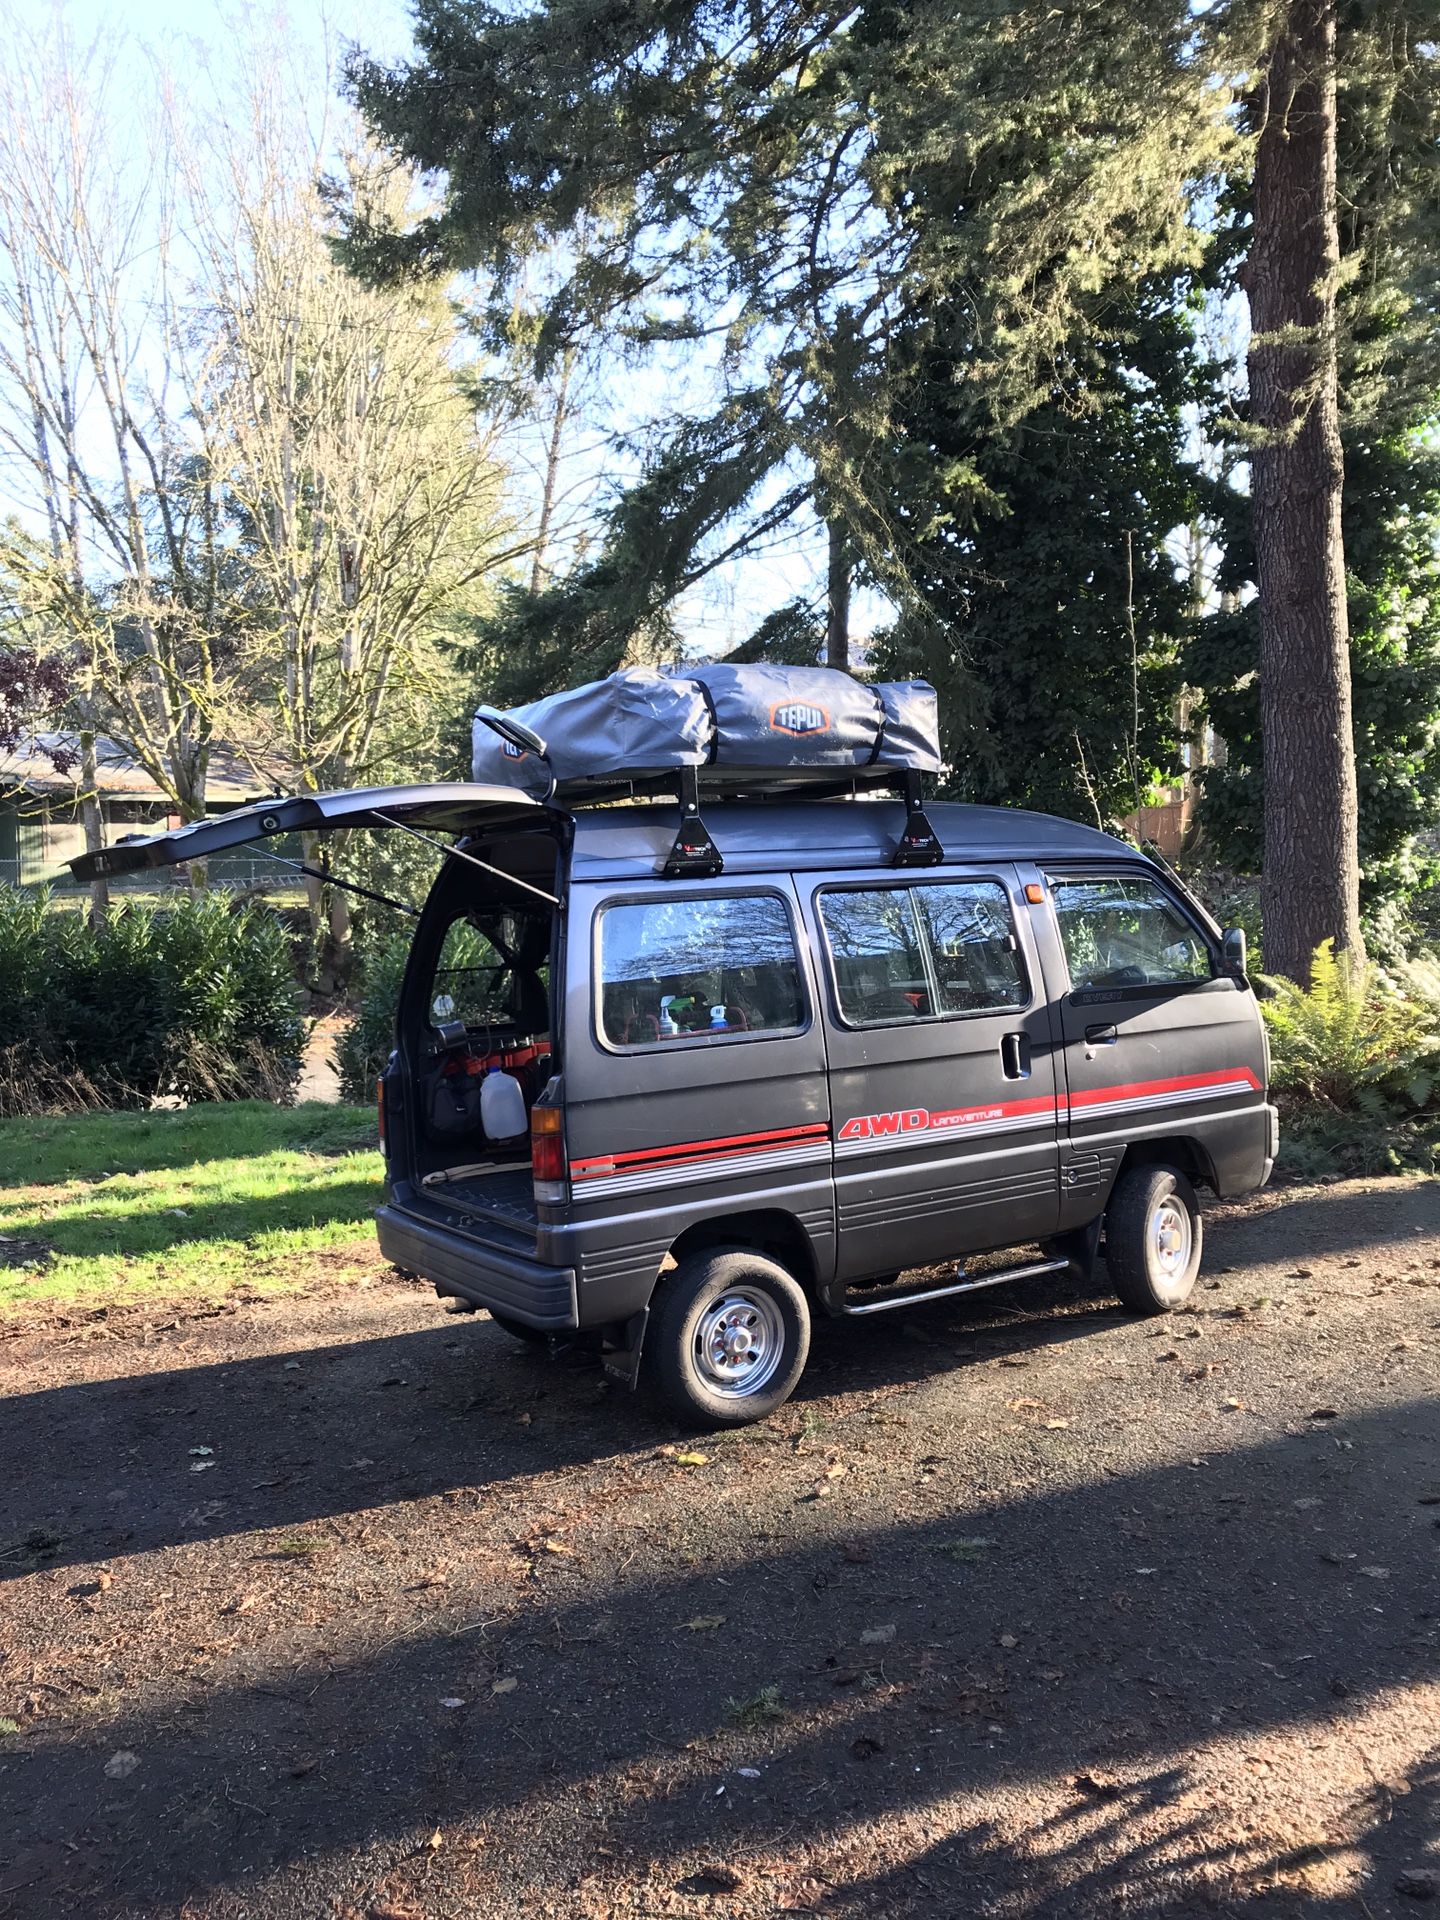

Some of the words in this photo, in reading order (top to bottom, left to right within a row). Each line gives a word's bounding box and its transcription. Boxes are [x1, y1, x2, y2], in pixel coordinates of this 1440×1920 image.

[780, 705, 821, 730] TEPUI
[838, 1108, 930, 1140] 4WD
[933, 1109, 1003, 1127] LANDVENTURE
